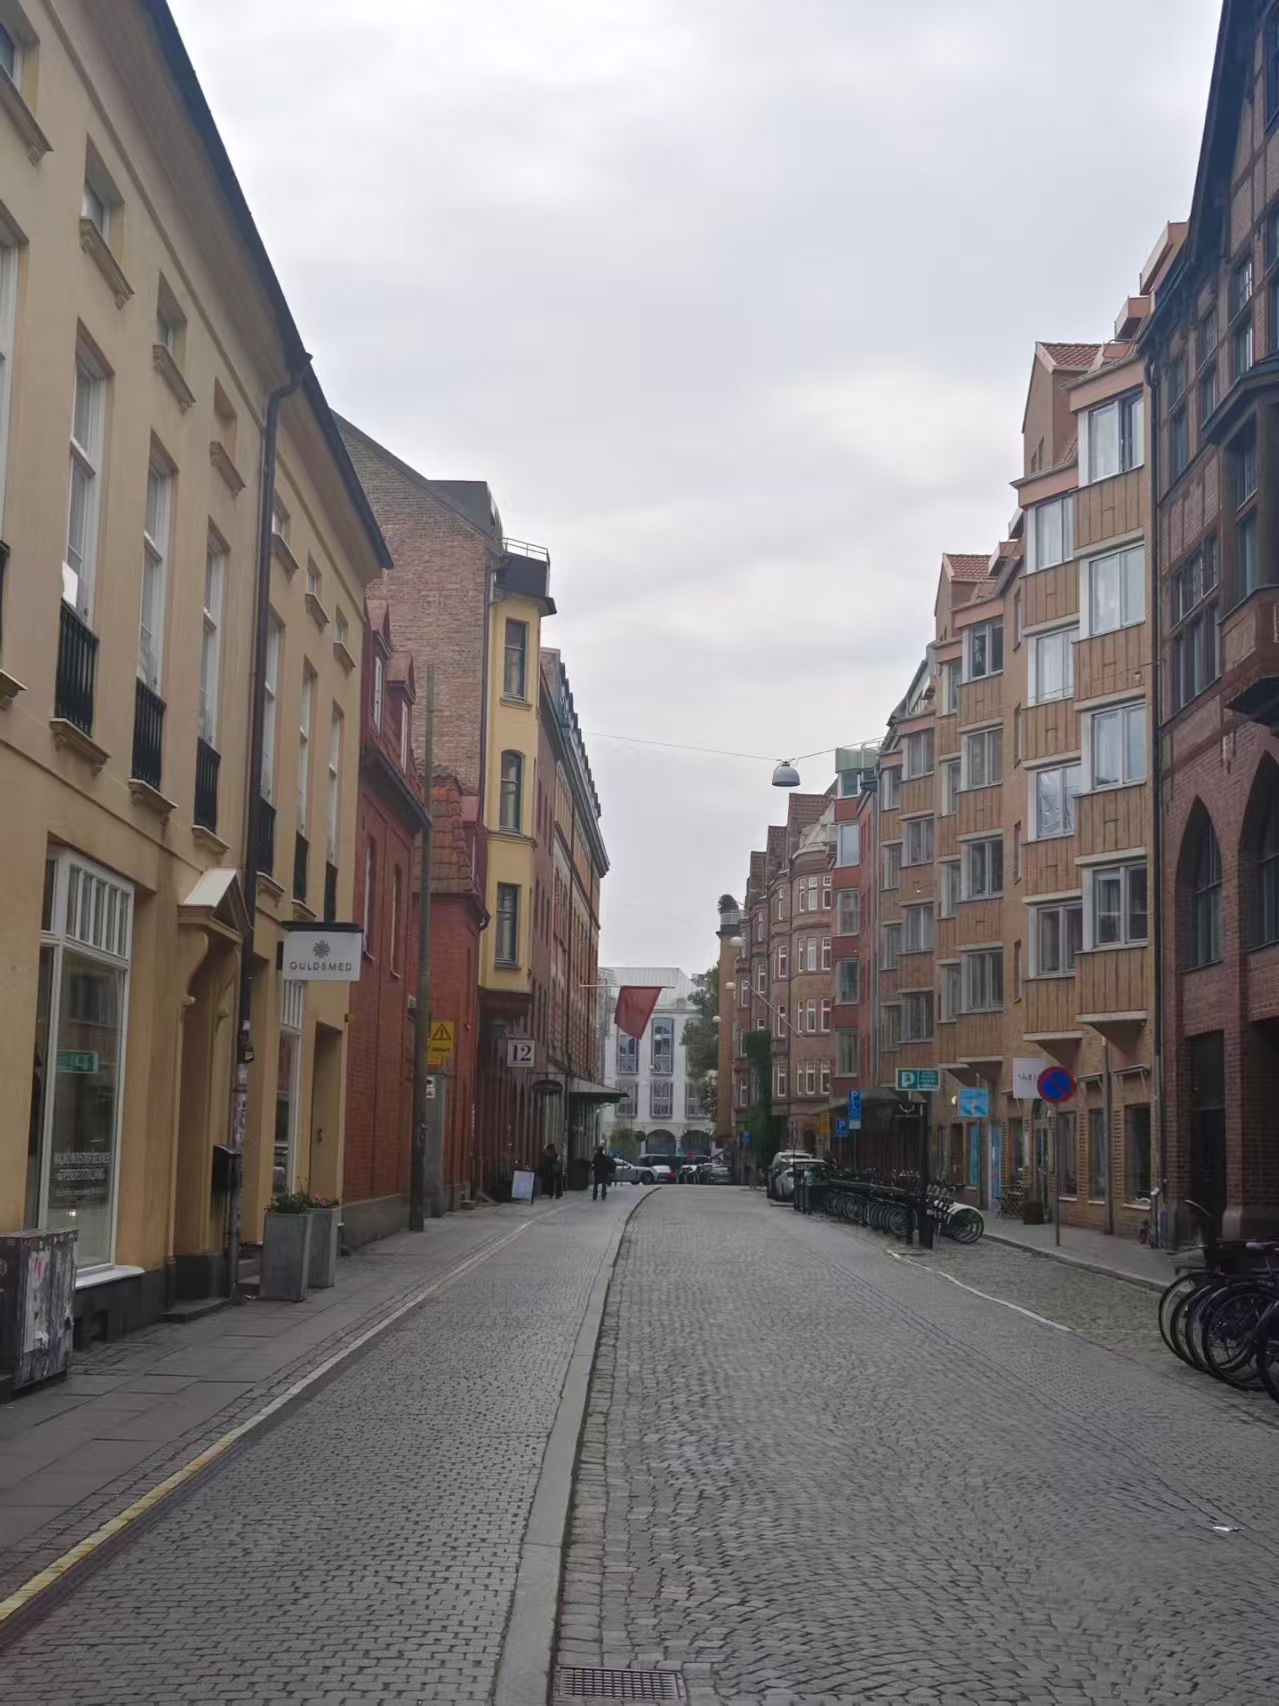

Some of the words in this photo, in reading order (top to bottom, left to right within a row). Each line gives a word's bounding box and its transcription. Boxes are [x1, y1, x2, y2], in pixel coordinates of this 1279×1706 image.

[289, 961, 352, 972] GULDSMED
[512, 1045, 532, 1062] 12
[901, 1072, 915, 1088] P
